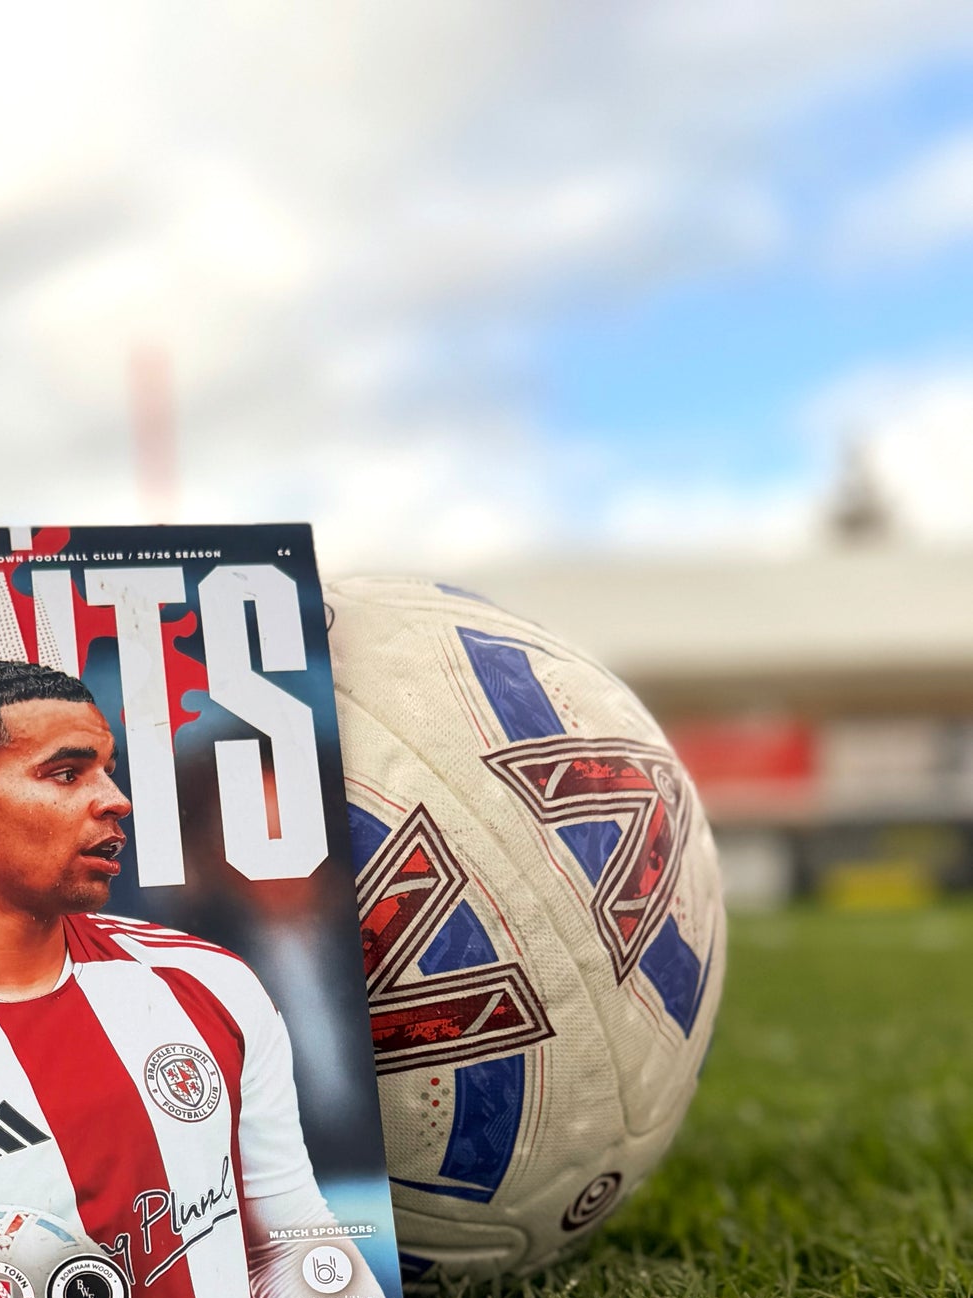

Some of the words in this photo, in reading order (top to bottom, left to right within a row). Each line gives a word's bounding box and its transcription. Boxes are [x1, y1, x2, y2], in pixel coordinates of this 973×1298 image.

[28, 553, 88, 562] FOOTBALL
[93, 552, 124, 561] CLUB
[137, 551, 171, 560] 25/26
[175, 550, 222, 559] SEASON
[148, 1047, 176, 1080] BRACKLEY
[180, 1047, 208, 1064] TOWN
[162, 1101, 208, 1119] FOOTBALL
[207, 1086, 218, 1109] CLUB
[269, 1229, 309, 1239] MATCH
[312, 1225, 377, 1236] SPONSORS:
[3, 1266, 29, 1289] TOWN
[61, 1263, 91, 1281] BOREHAM
[92, 1263, 114, 1279] WOOD
